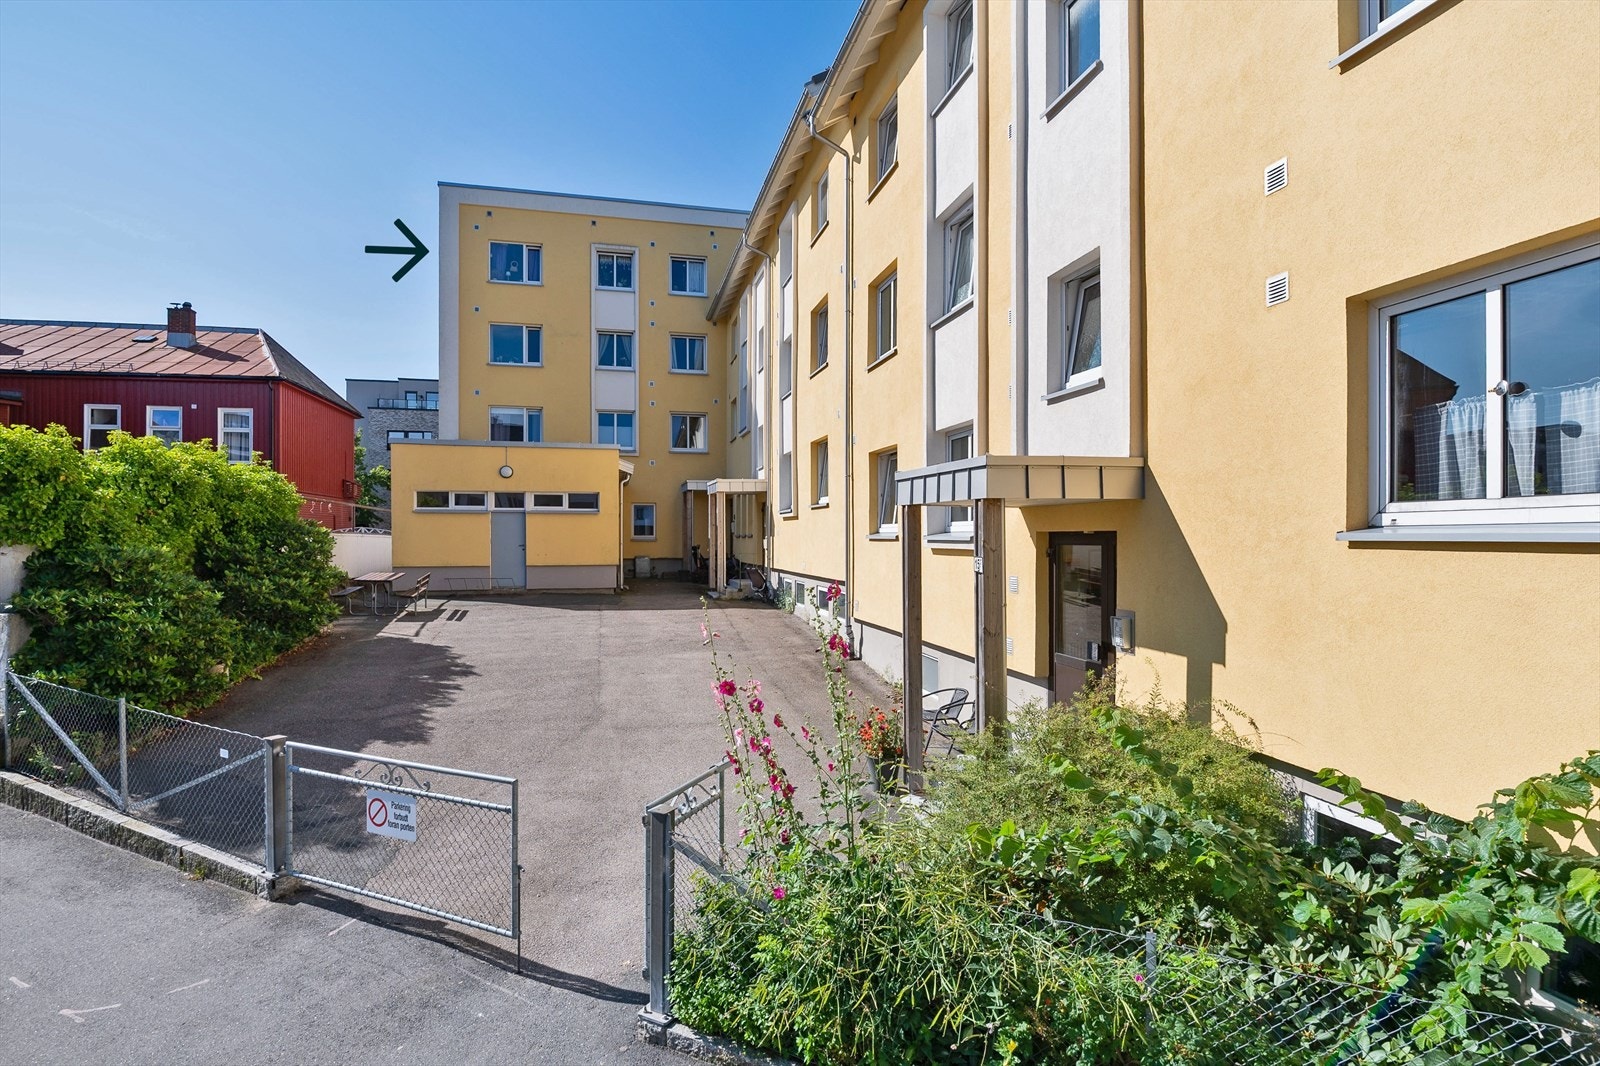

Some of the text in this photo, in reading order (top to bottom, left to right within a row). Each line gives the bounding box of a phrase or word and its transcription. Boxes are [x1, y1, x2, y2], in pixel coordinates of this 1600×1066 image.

[391, 801, 411, 813] Parkering
[394, 812, 409, 822] forbudt
[388, 819, 415, 832] foran porten
